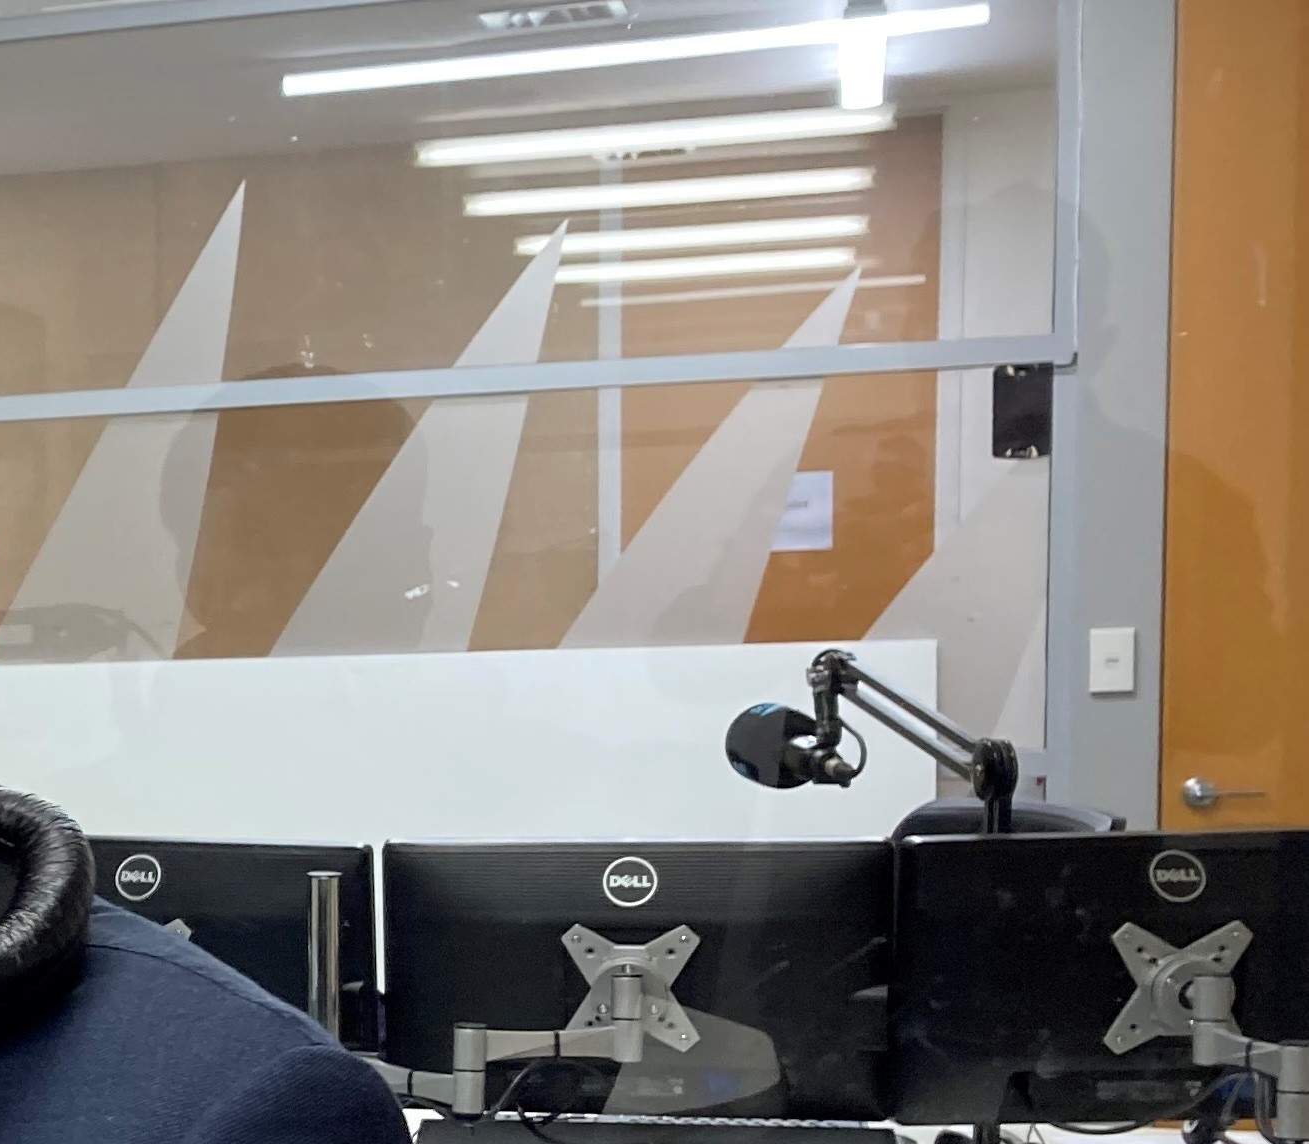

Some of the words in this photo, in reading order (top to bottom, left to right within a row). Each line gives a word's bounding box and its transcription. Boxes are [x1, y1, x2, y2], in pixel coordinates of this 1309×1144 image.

[121, 870, 155, 883] DELL
[609, 874, 652, 888] DELL
[1156, 868, 1200, 883] DELL
